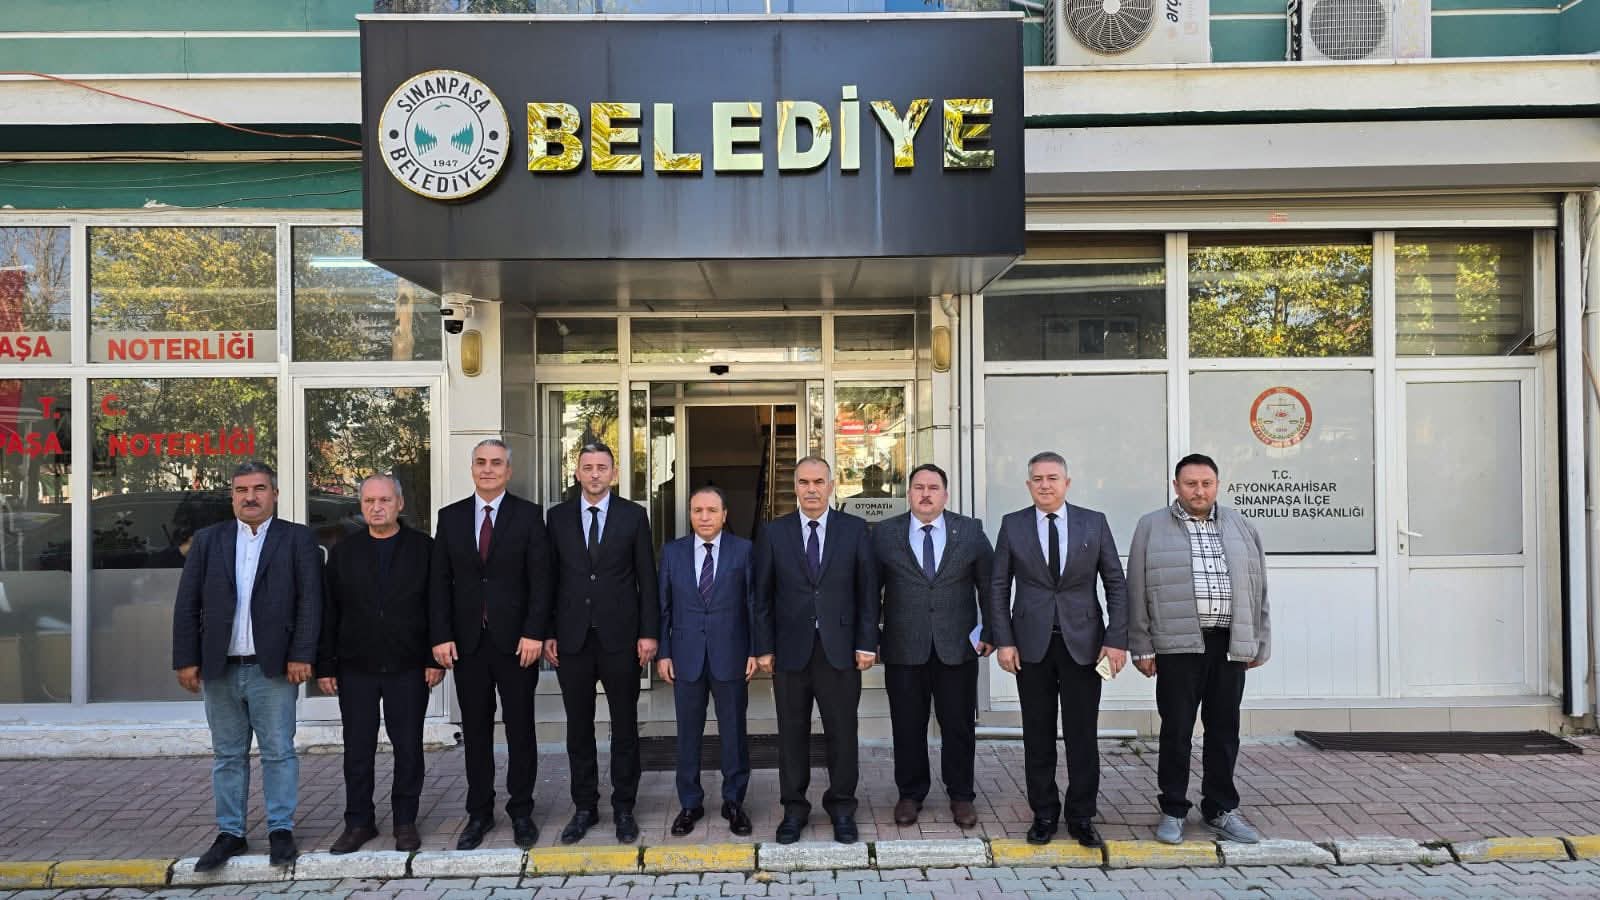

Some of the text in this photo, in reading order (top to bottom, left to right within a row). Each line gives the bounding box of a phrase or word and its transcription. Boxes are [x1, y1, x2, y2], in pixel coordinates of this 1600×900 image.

[526, 85, 996, 172] BELEDİYE
[390, 147, 500, 193] BELEDİYESİ
[433, 159, 459, 167] 1947
[107, 333, 255, 361] NOTERLİĞİ
[38, 394, 127, 420] T. C.
[108, 426, 256, 457] NOTERLİĞİ
[1272, 470, 1292, 479] T.C.
[1227, 481, 1337, 493] AFYONKARAHİSAR
[1234, 494, 1331, 508] SİNANPAŞA İLÇE
[1240, 507, 1364, 520] KURULU BAŞKANLIĞI
